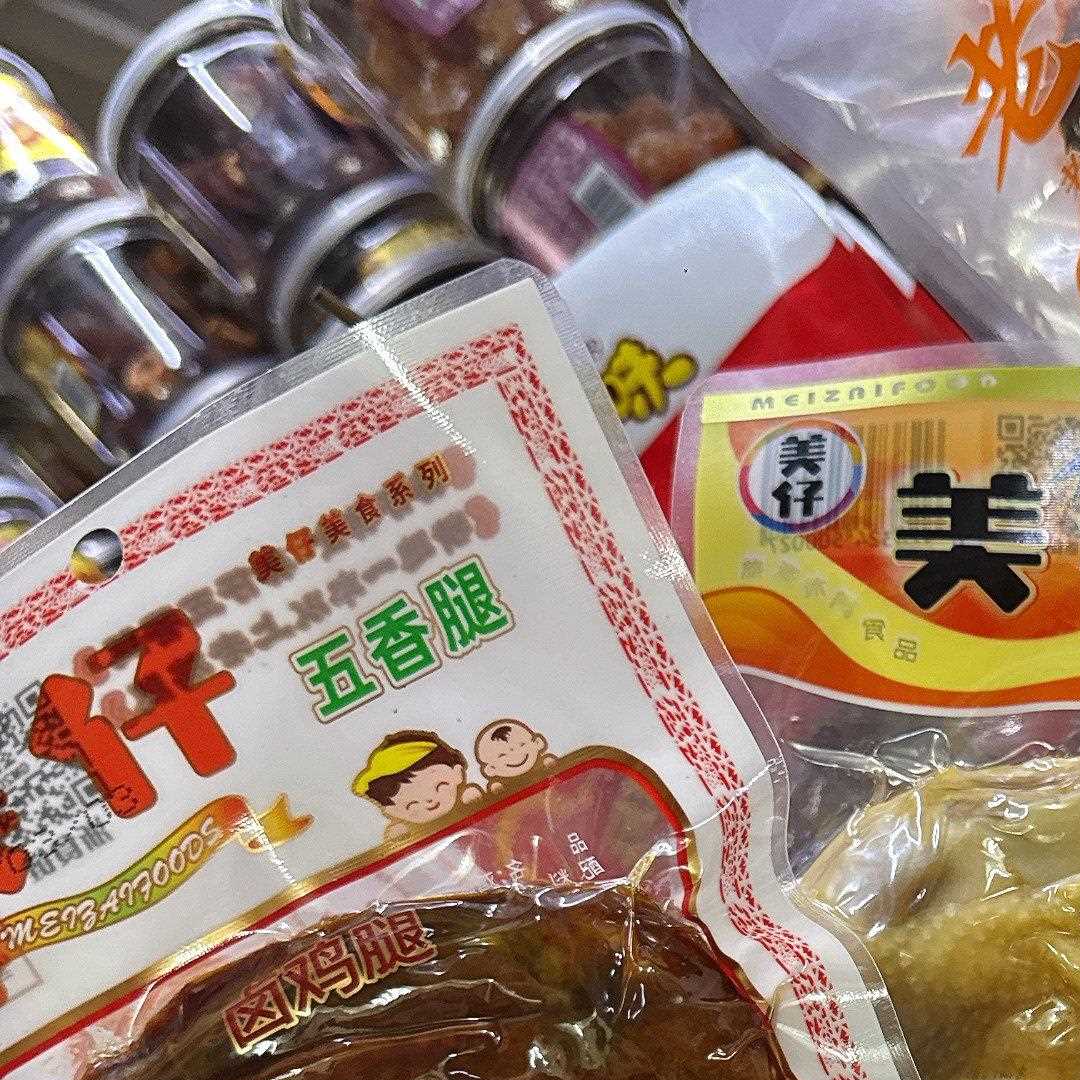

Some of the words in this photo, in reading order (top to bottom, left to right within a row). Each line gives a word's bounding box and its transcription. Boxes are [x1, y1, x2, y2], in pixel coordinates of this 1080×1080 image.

[246, 453, 453, 584] 美仔美食系列
[771, 433, 828, 519] 美仔
[290, 557, 515, 722] 五香腿
[222, 911, 438, 1054] 卤鸡腿
